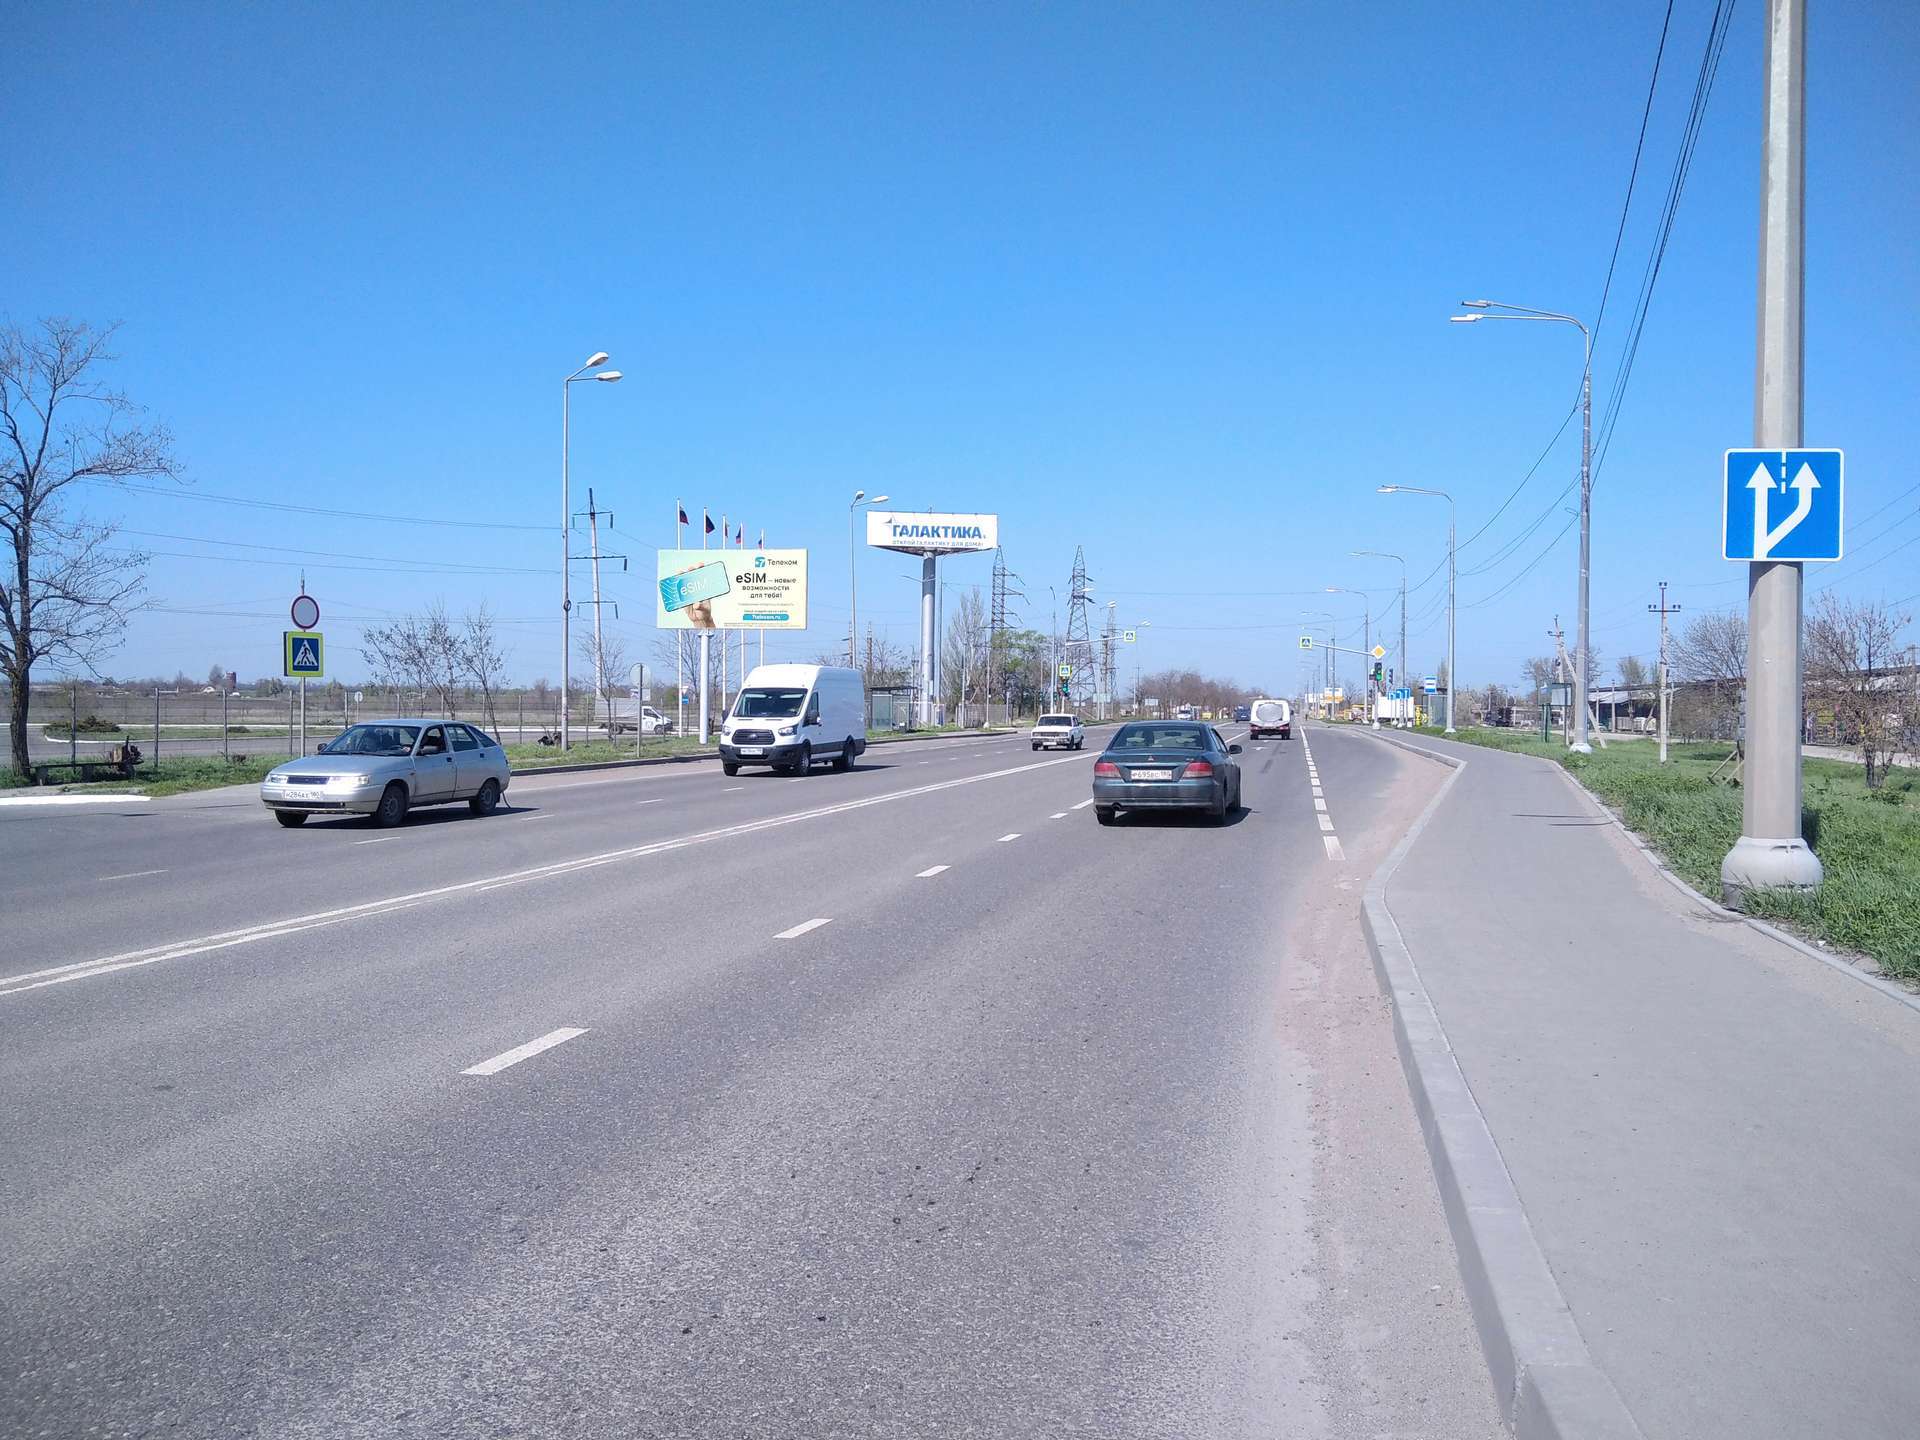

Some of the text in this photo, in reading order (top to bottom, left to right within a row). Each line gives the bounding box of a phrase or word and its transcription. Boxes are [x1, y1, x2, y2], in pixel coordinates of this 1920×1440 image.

[892, 525, 982, 539] ГАЛАКТИКА
[736, 572, 766, 583] eSIM
[680, 579, 708, 595] eSIM
